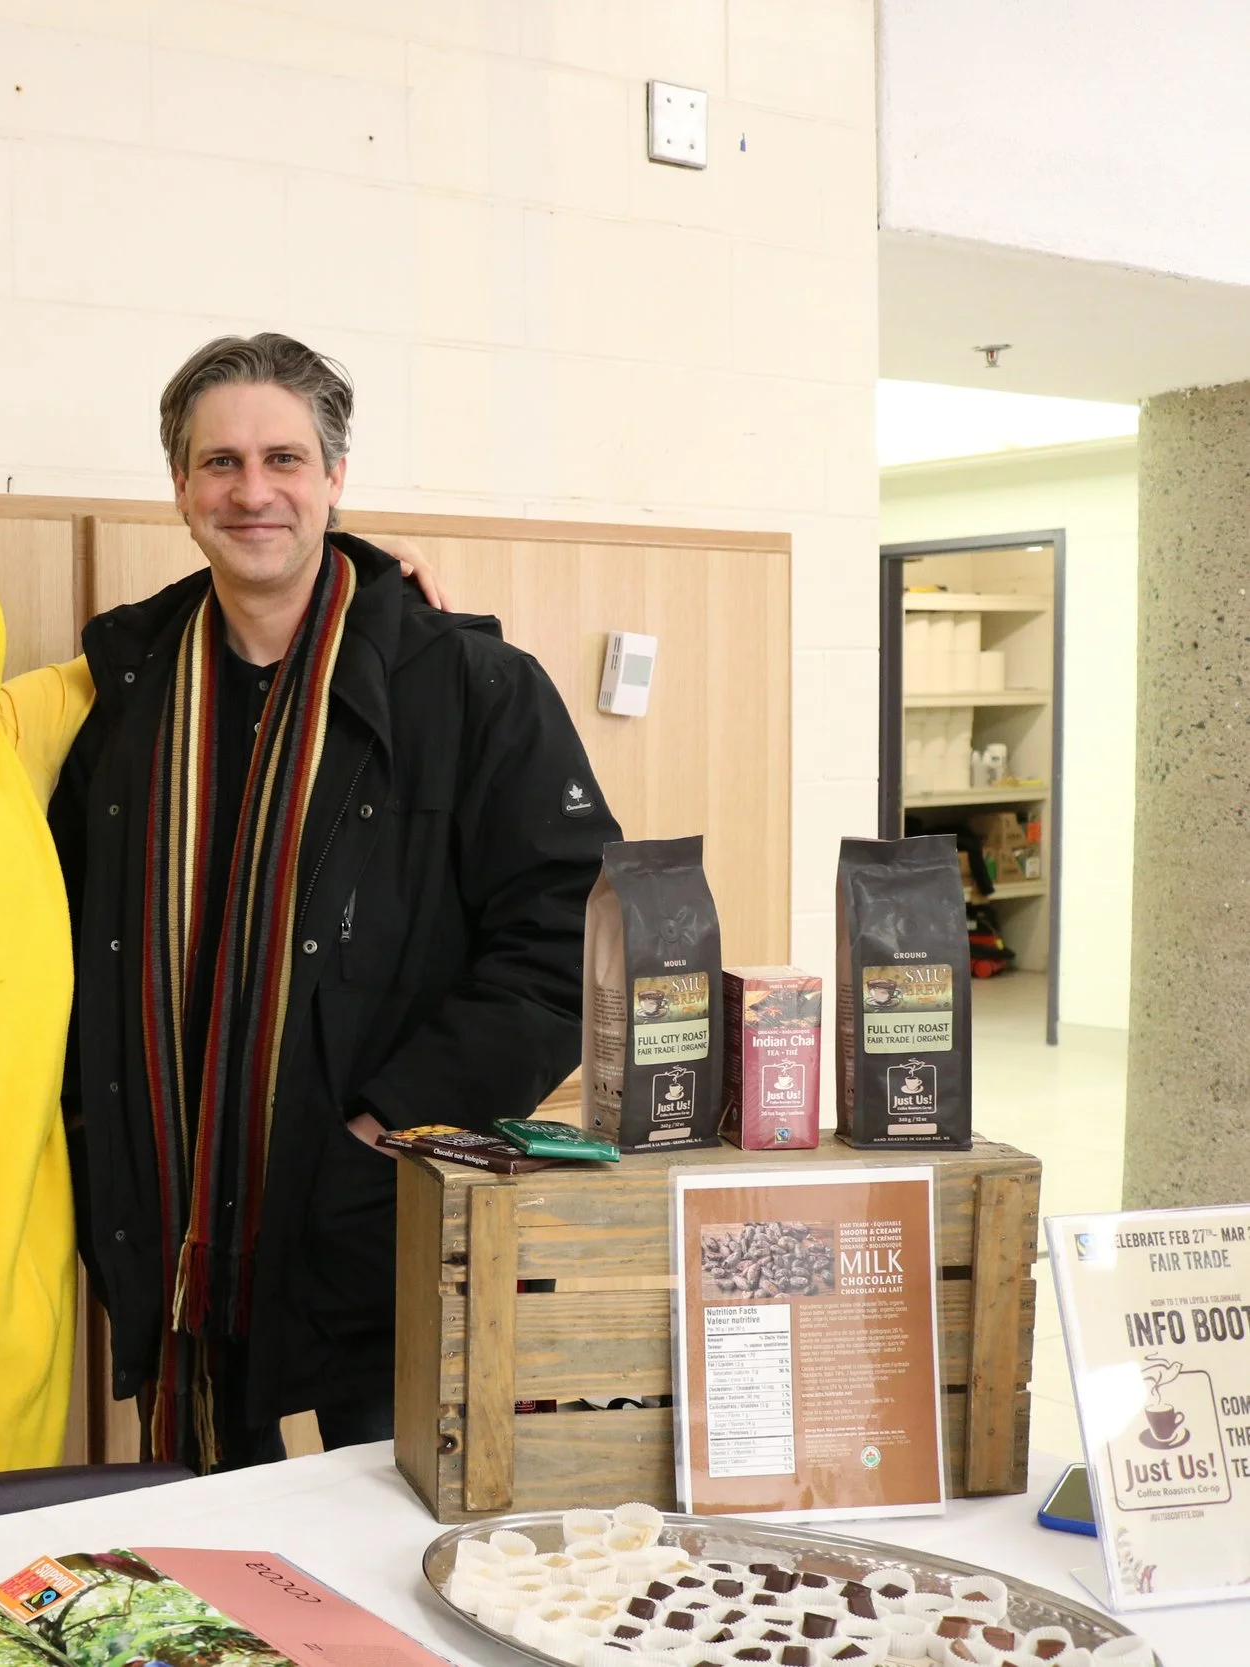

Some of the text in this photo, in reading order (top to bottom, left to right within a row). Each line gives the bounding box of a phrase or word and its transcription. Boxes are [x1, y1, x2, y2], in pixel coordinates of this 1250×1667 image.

[893, 951, 928, 960] GROUND
[663, 959, 688, 968] MOULU
[905, 967, 947, 983] SMU
[672, 975, 706, 993] SMU
[905, 983, 949, 996] BREW
[671, 991, 706, 1006] BREW
[867, 1022, 950, 1034] FULL CITY ROAST
[638, 1030, 708, 1046] FULL CITY ROAST
[752, 1034, 815, 1048] Indian Chai
[867, 1034, 950, 1044] FAIR TRADE ORGANIC
[637, 1041, 708, 1056] FAIR TRADE ORGANIC
[767, 1048, 799, 1057] TEA THÉ
[766, 1090, 802, 1103] Just Us!
[892, 1094, 933, 1109] Just Us!
[656, 1100, 691, 1116] Just Us!
[433, 1148, 454, 1158] Chocolat
[1114, 1231, 1167, 1249] ELEBRATE
[1169, 1230, 1191, 1246] FEB
[1221, 1226, 1246, 1243] MAR
[840, 1249, 904, 1275] MILK
[1149, 1249, 1231, 1272] FAIR TRADE
[841, 1275, 903, 1286] CHOCOLATE
[841, 1287, 876, 1295] CHOCOLAT
[707, 1307, 758, 1316] Nutrition Facts
[707, 1316, 760, 1325] Valeur nutritive
[1124, 1309, 1186, 1347] INFO
[1125, 1452, 1217, 1493] Just Us!
[1137, 1484, 1220, 1498] Coffee Roasters Co-op
[35, 1563, 78, 1593] SUPPORT
